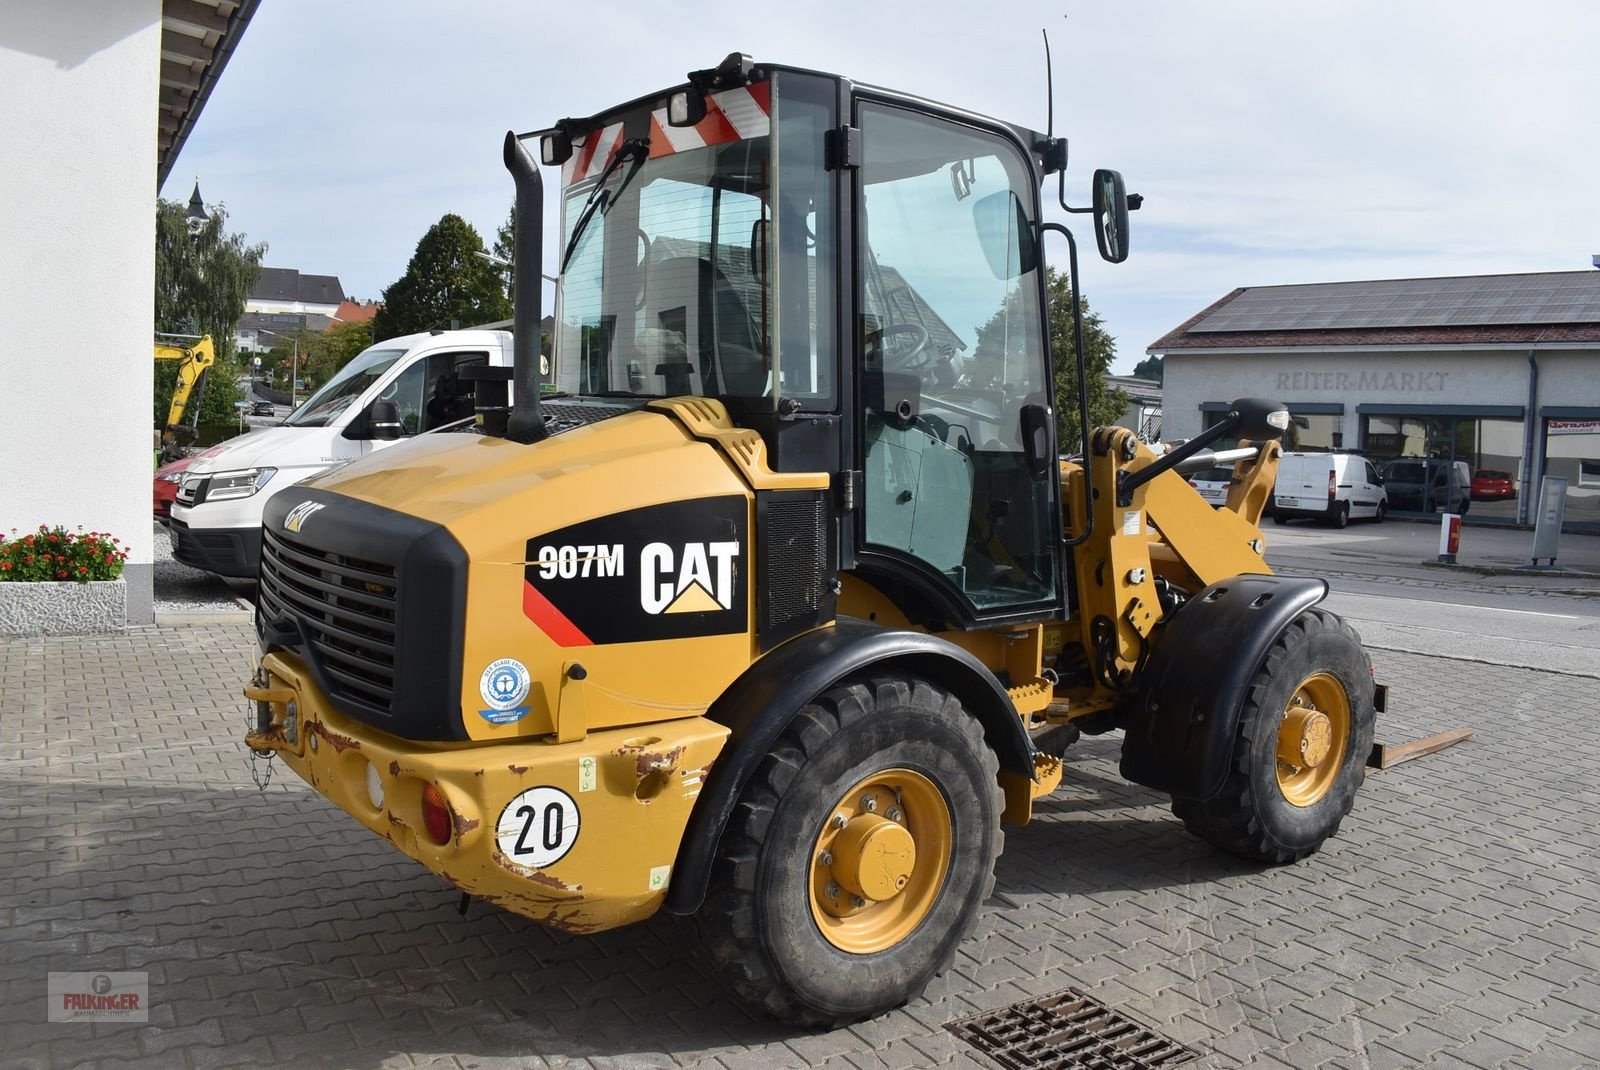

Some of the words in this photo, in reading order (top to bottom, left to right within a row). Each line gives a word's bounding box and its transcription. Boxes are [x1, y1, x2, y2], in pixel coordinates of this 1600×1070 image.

[284, 500, 326, 533] CAT
[538, 543, 625, 580] 907M
[640, 541, 740, 615] CAT
[514, 802, 564, 856] 20
